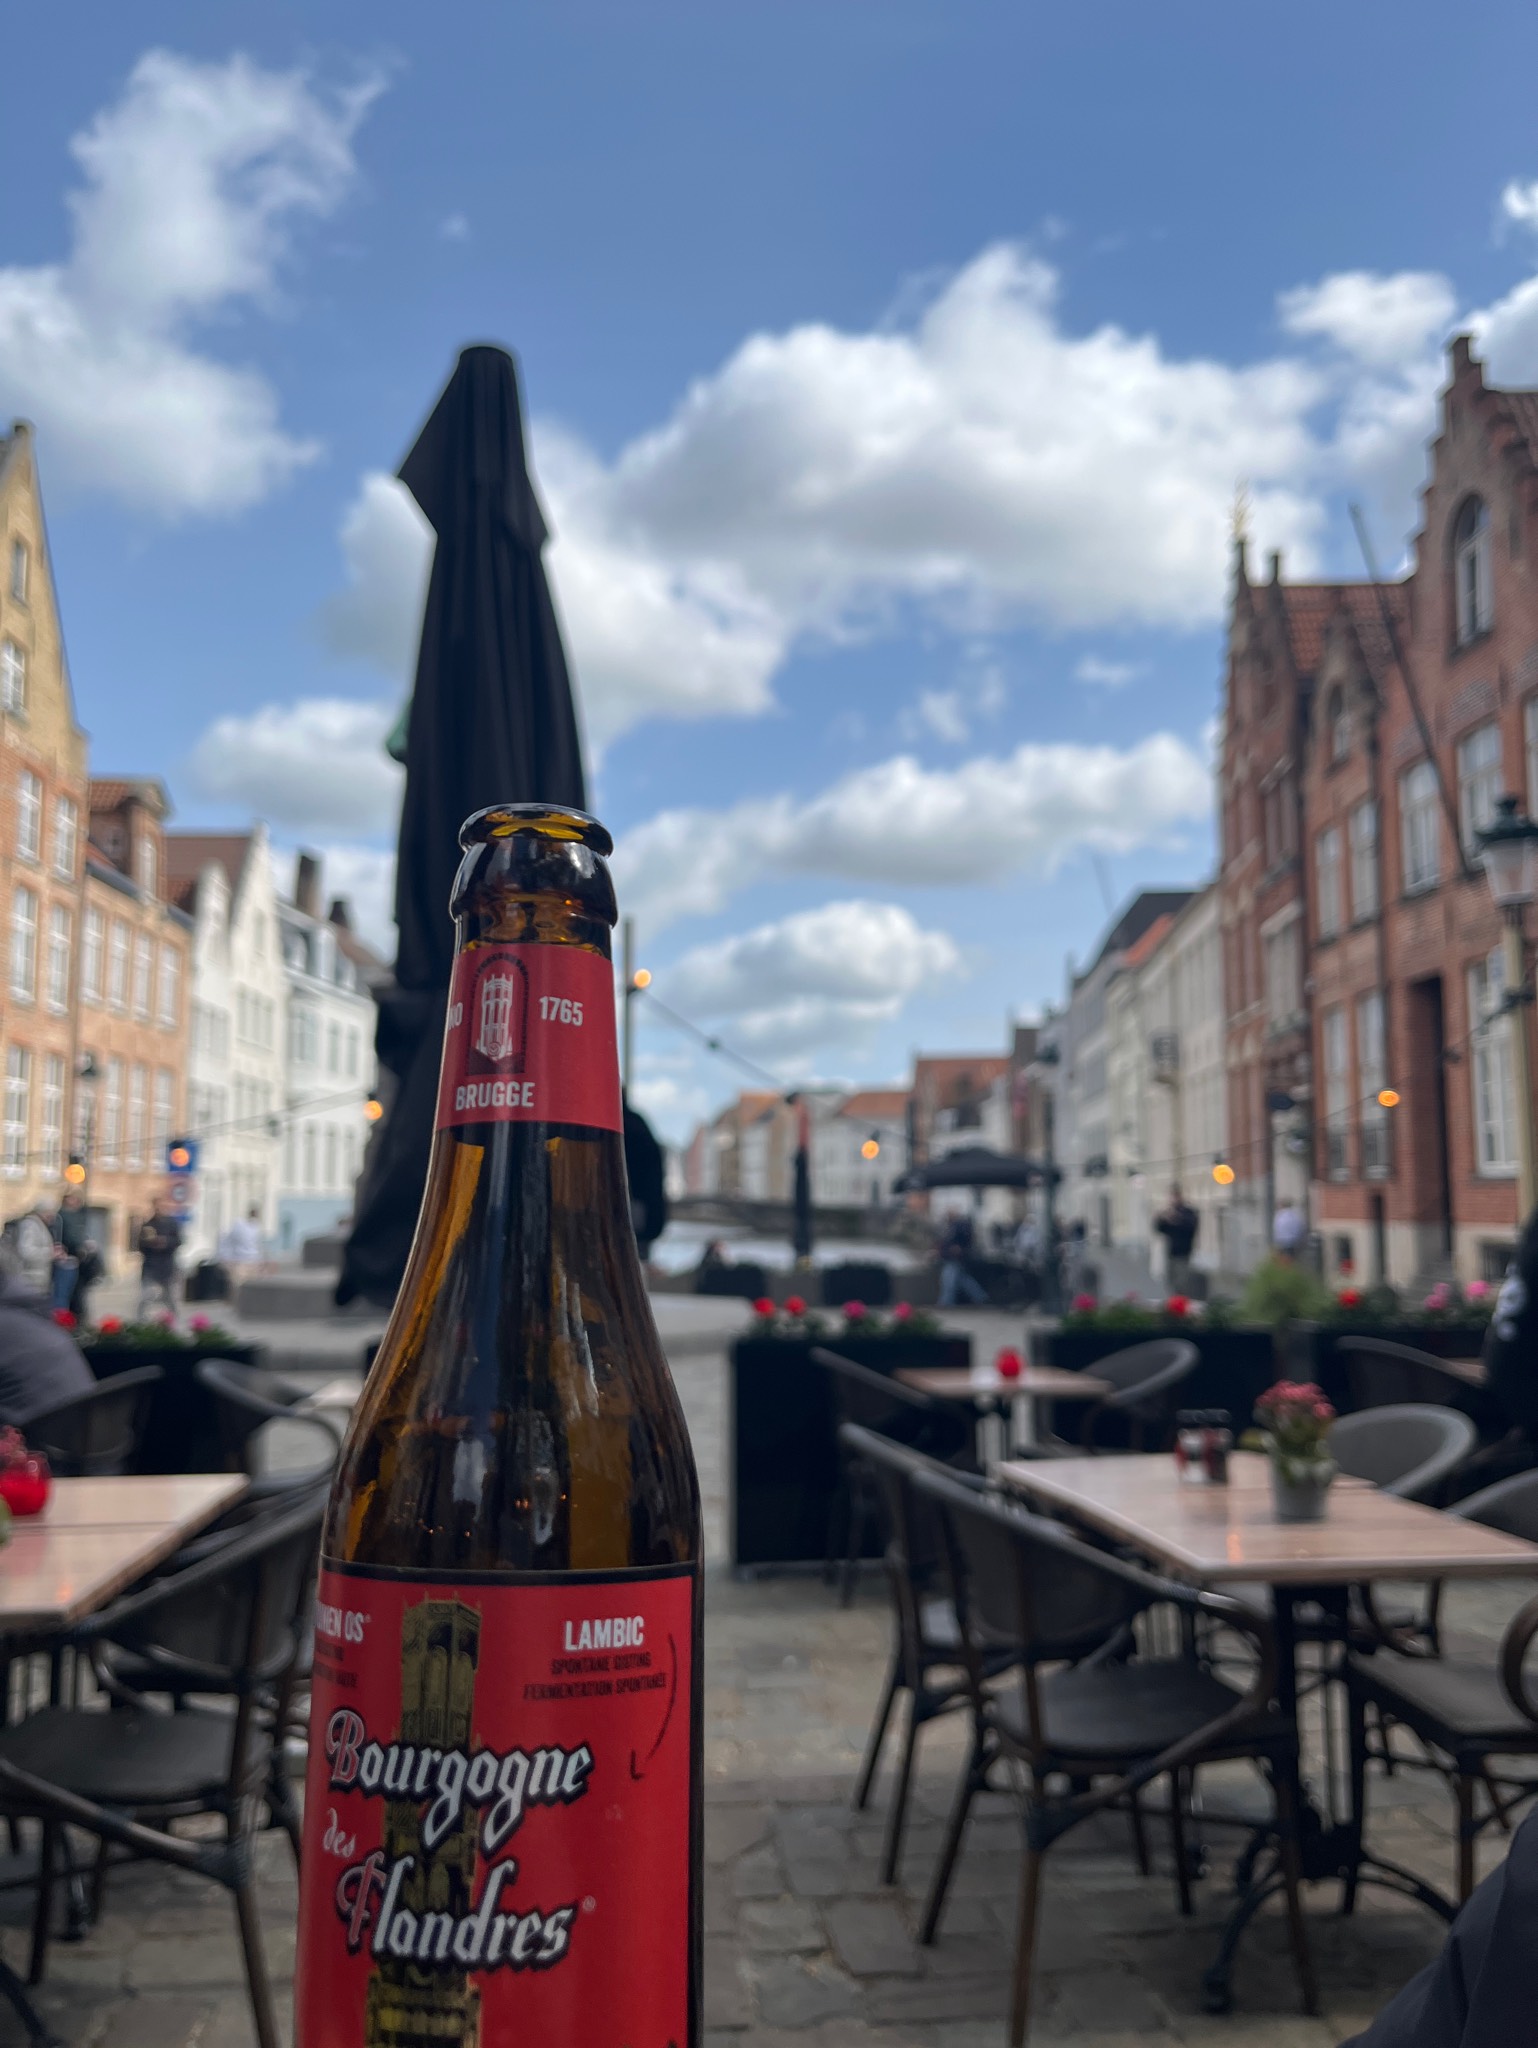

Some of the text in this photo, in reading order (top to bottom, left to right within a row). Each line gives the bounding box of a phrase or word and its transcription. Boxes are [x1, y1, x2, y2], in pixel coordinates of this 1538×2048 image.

[539, 995, 584, 1027] 1765
[455, 1081, 535, 1112] BRUGGE
[564, 1615, 644, 1651] LAMBIC
[325, 1709, 593, 1853] Bourgogne
[323, 1807, 356, 1858] des
[336, 1850, 575, 1964] Flandres
